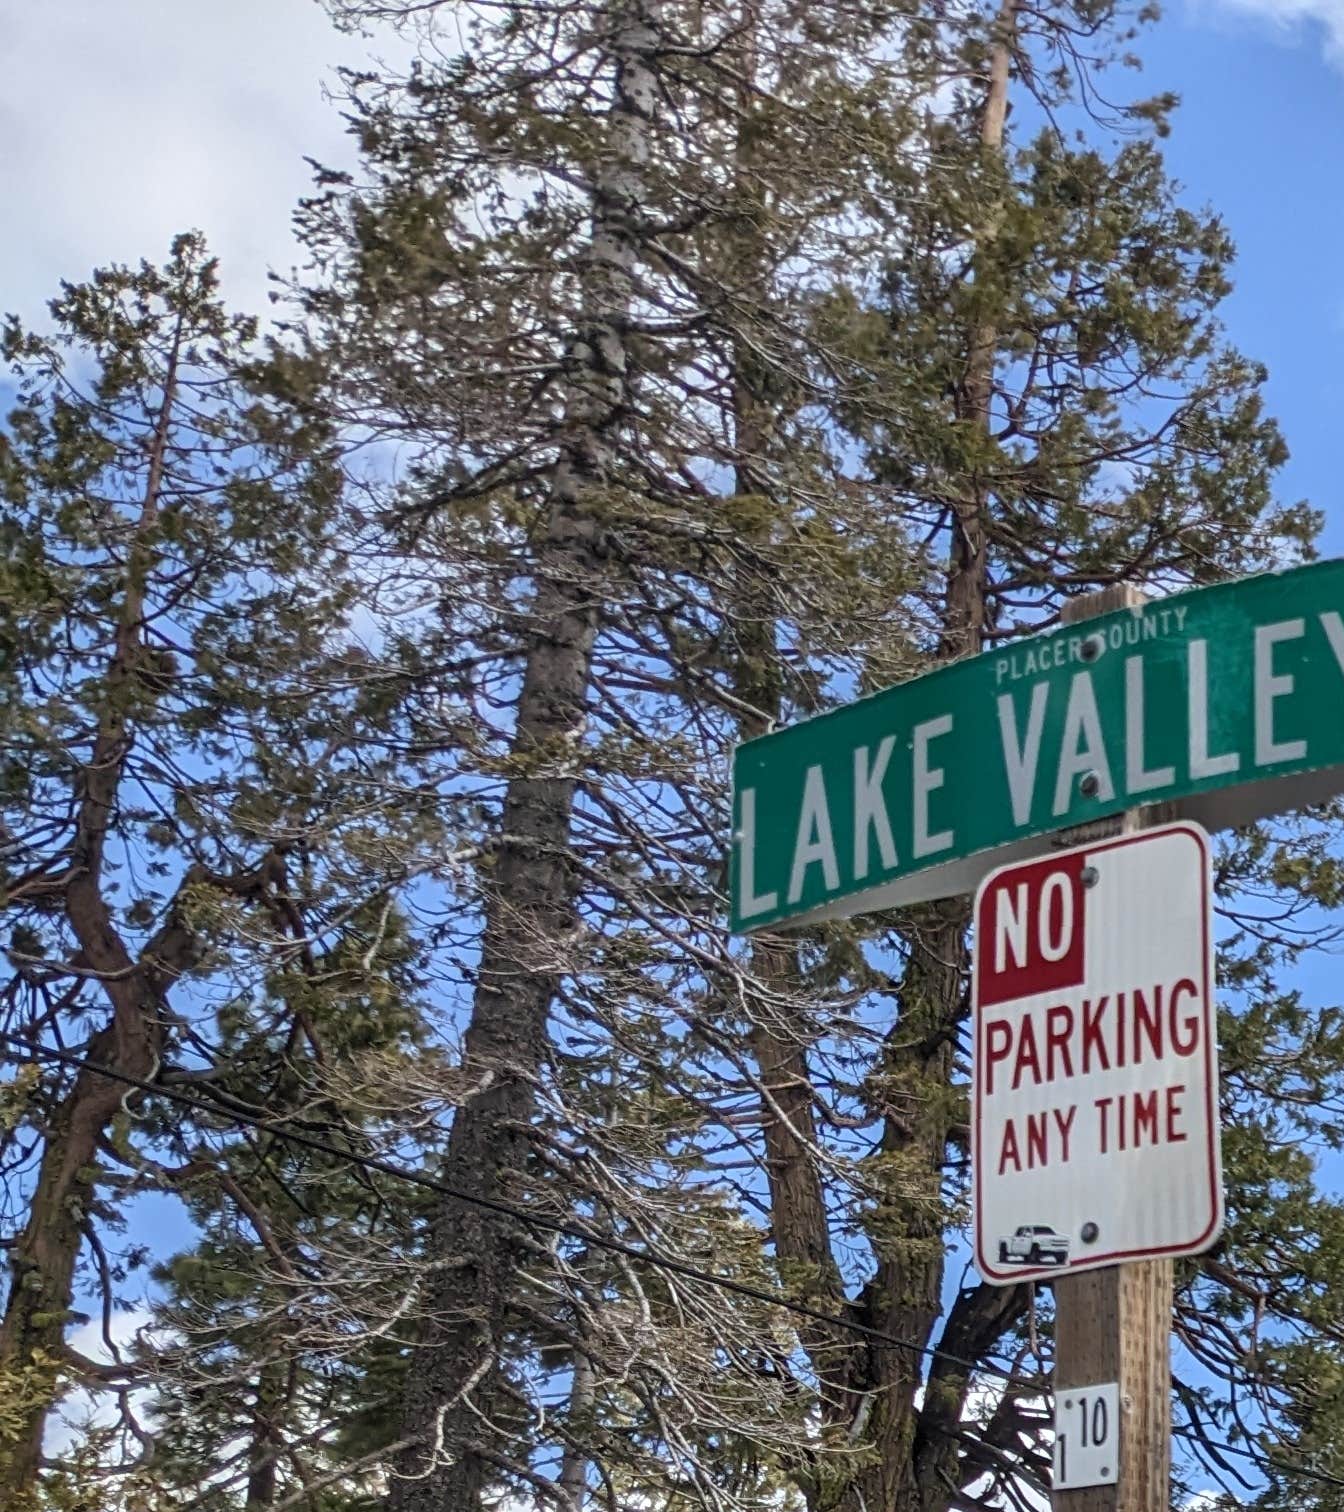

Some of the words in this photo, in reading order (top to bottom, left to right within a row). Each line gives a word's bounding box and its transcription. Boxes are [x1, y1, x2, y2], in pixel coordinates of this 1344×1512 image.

[996, 636, 1081, 685] PLACER
[1098, 606, 1188, 650] OUNTY
[738, 713, 954, 918] LAKE
[995, 871, 1075, 975] NO
[985, 978, 1200, 1096] PARKING
[998, 1105, 1077, 1175] ANY
[1095, 1085, 1188, 1154] TIME
[1078, 1397, 1108, 1448] 10
